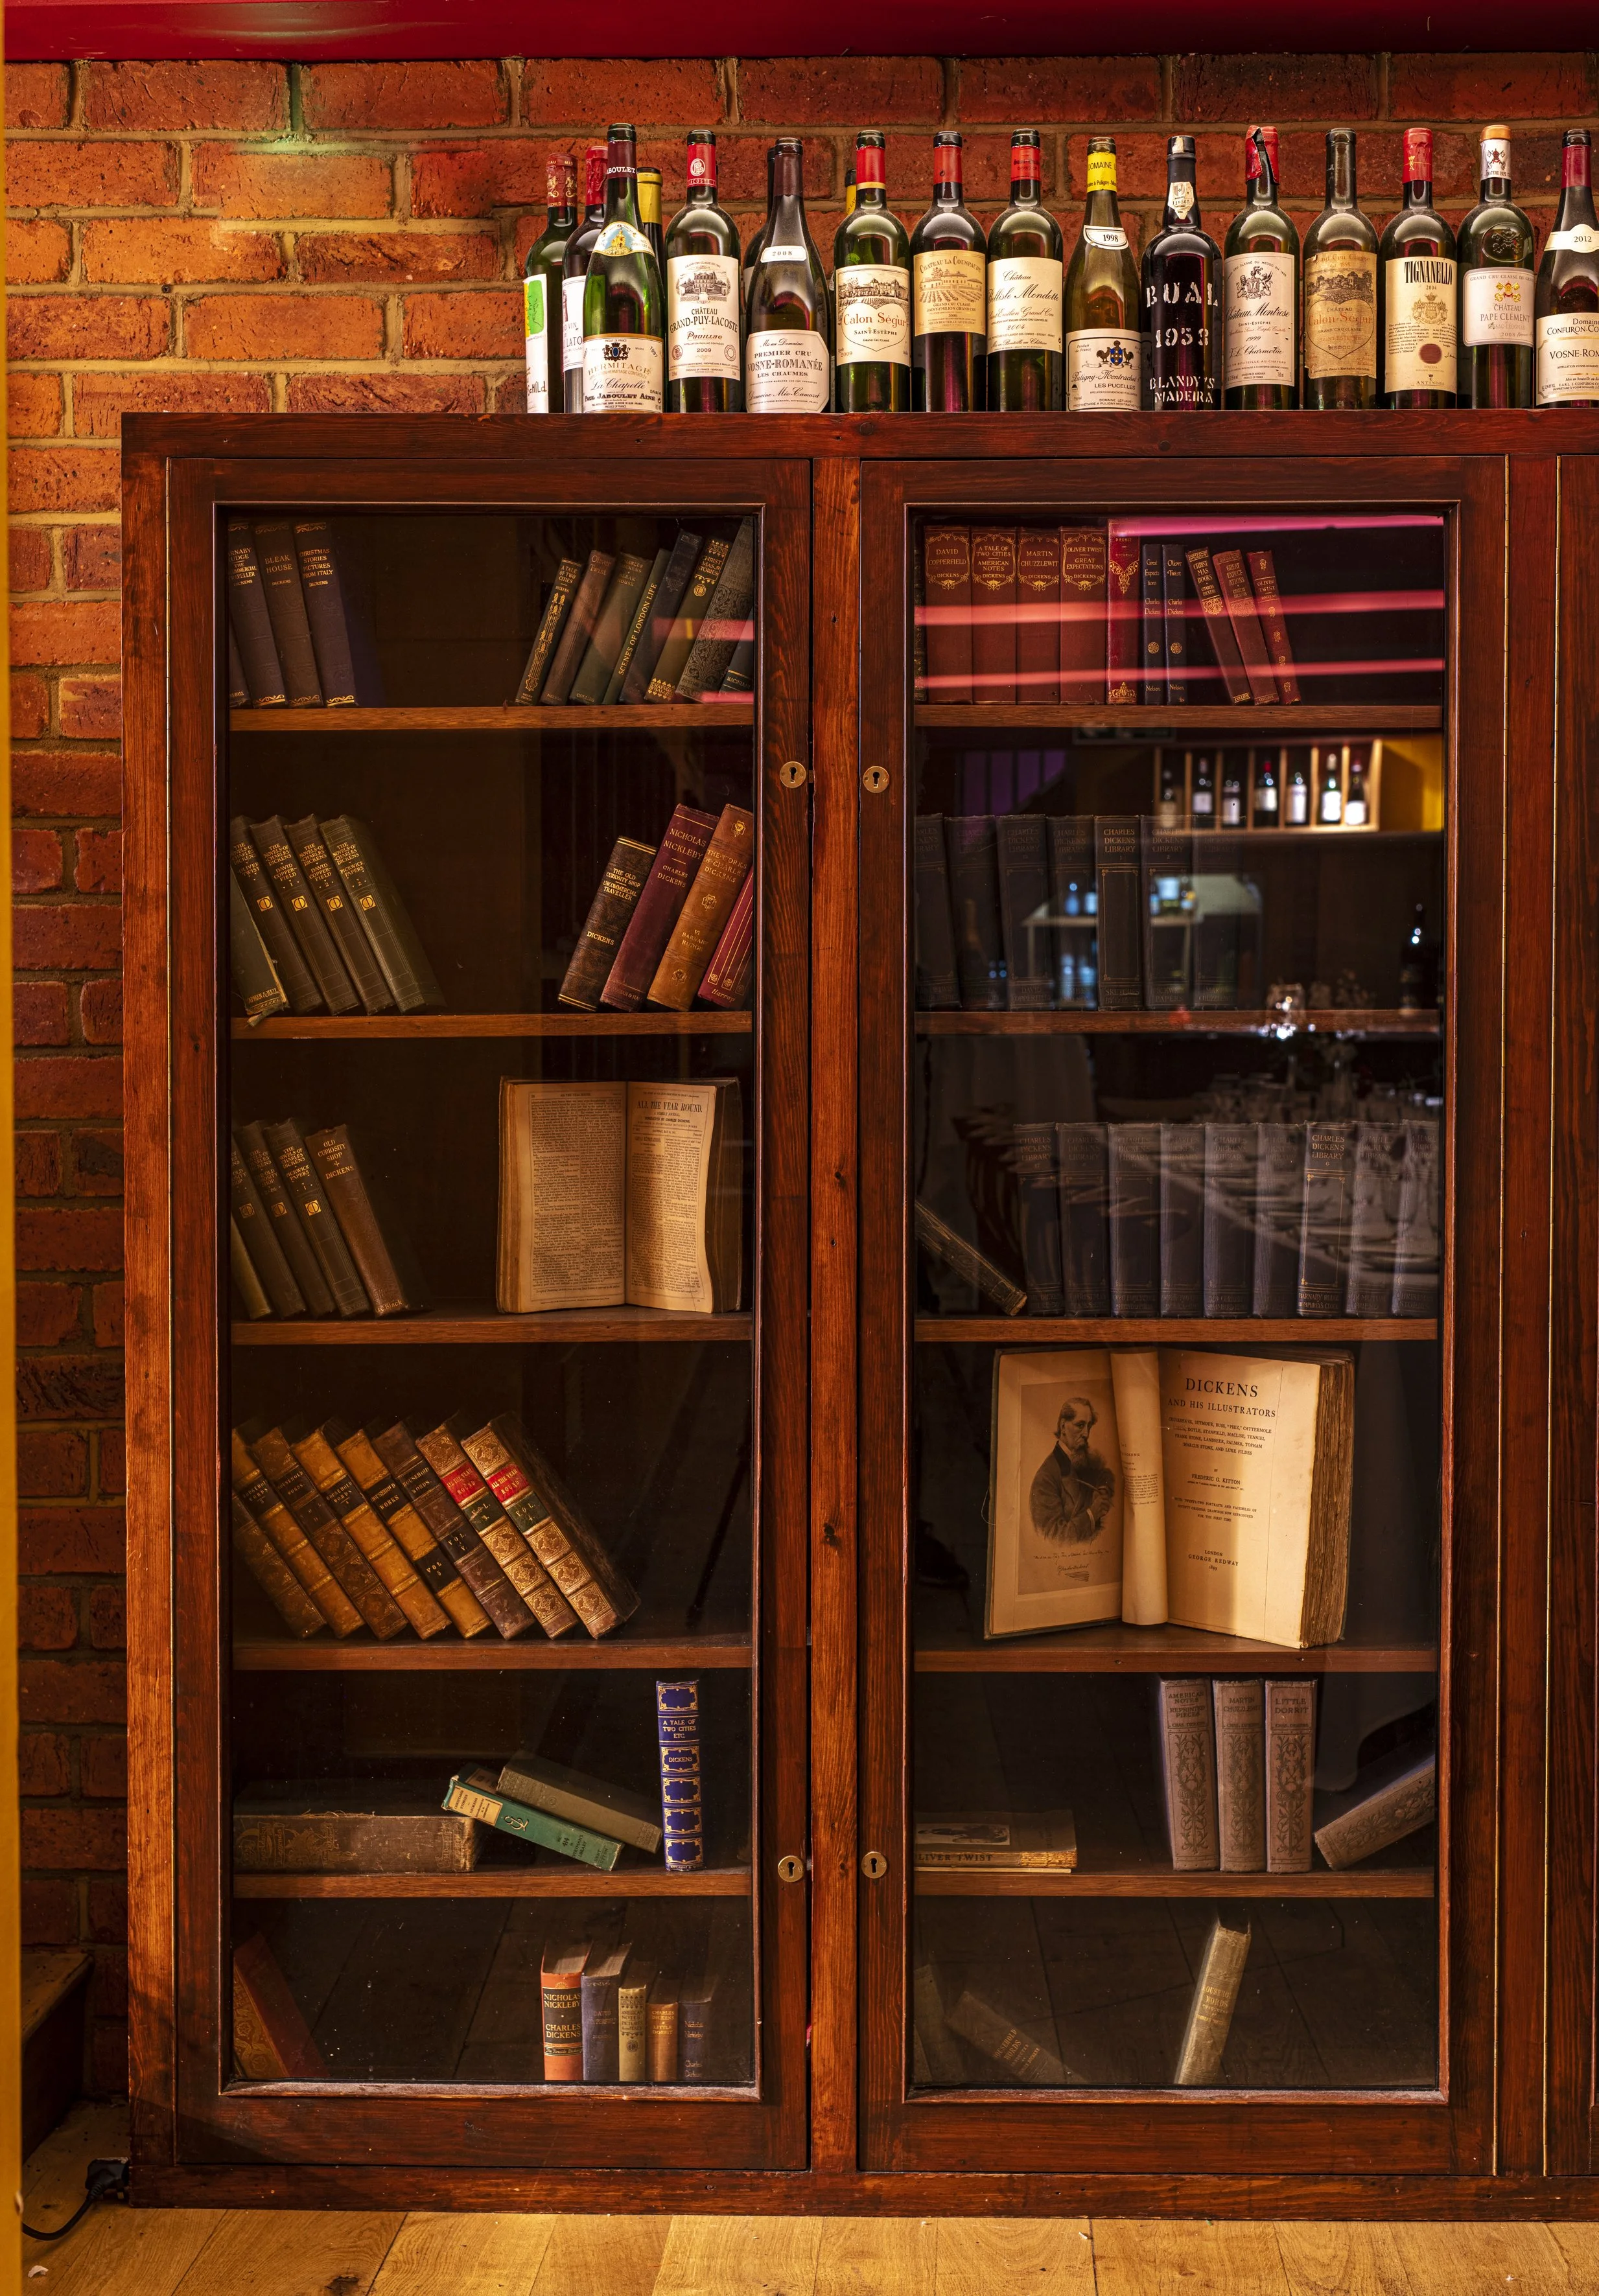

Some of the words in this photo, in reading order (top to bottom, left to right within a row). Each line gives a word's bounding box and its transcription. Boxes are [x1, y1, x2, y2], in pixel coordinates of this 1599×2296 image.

[1103, 234, 1119, 242] 1998
[920, 259, 944, 273] CHATEAU
[953, 256, 981, 273] COUSPAUDE
[1003, 270, 1032, 281] Château
[1405, 261, 1453, 285] TIGNANELLO
[1014, 284, 1059, 301] Mondotte
[1146, 281, 1218, 307] BUAL
[1251, 302, 1290, 317] Montrose
[670, 316, 738, 333] GRAND-PUY-LACOSTE
[844, 314, 872, 325] Calon
[878, 312, 906, 328] Ségur
[588, 363, 649, 375] HERMITAGE
[747, 358, 823, 373] VOSNE-ROMANÉE
[1071, 370, 1136, 382] Puligny-Montrachet
[1149, 375, 1215, 389] BLANDY'S
[606, 378, 647, 391] Chapelle
[1154, 390, 1213, 404] MADEIRA
[264, 555, 290, 564] BLEAK
[591, 555, 611, 566] Oliver
[266, 564, 293, 574] HOUSE
[590, 564, 607, 575] Twist
[1197, 575, 1213, 584] BOOKS
[618, 645, 635, 675] SCENES
[635, 603, 651, 634] LONDON
[646, 583, 657, 601] LIFE
[1145, 684, 1161, 693] Nelson
[1169, 683, 1185, 691] Nelson
[670, 828, 706, 847] NICHOLAS
[663, 840, 703, 860] NICKLEBY
[1104, 845, 1136, 853] LIBRARY
[268, 854, 292, 866] DICKENS
[304, 854, 327, 866] DICKENS
[337, 853, 360, 865] DICKENS
[276, 863, 293, 873] DAVID
[311, 863, 328, 873] DAVID
[344, 866, 364, 877] PAPERS
[613, 868, 625, 877] THE
[662, 865, 688, 878] CHARLES
[280, 872, 296, 881] FIELD
[315, 872, 332, 881] FIELD
[605, 872, 628, 883] CURIOSITY
[629, 879, 641, 888] SHOP
[657, 872, 686, 888] DICKENS
[603, 881, 637, 897] UNCOMMERCIAL
[603, 886, 633, 901] TRAVELLER
[587, 931, 615, 945] DICKENS
[711, 988, 736, 1003] Harrap
[664, 1102, 679, 1110] YEAR
[1019, 1136, 1051, 1144] CHARLES
[318, 1143, 345, 1157] CURIOSITY
[1020, 1144, 1052, 1153] DICKENS
[1312, 1143, 1345, 1152] DICKENS
[327, 1152, 342, 1161] SHOP
[1312, 1152, 1344, 1160] LIBRARY
[325, 1166, 354, 1179] DICKENS
[1185, 1378, 1258, 1398] DICKENS
[1168, 1398, 1185, 1407] AND
[1189, 1400, 1204, 1409] HIS
[1208, 1402, 1276, 1417] ILLUSTRATORS
[402, 1466, 430, 1487] HOUSEHOLD
[506, 1469, 518, 1479] YEAR
[371, 1482, 396, 1503] HOUSEHOLD
[457, 1480, 476, 1495] ROUND
[500, 1479, 519, 1495] ROUND
[1215, 1558, 1239, 1566] REDWAY
[1229, 1696, 1255, 1704] MARTIN
[1206, 1996, 1228, 2007] WORDS
[995, 2029, 1017, 2058] OUSEHOLD
[1003, 2039, 1021, 2059] WORDS
